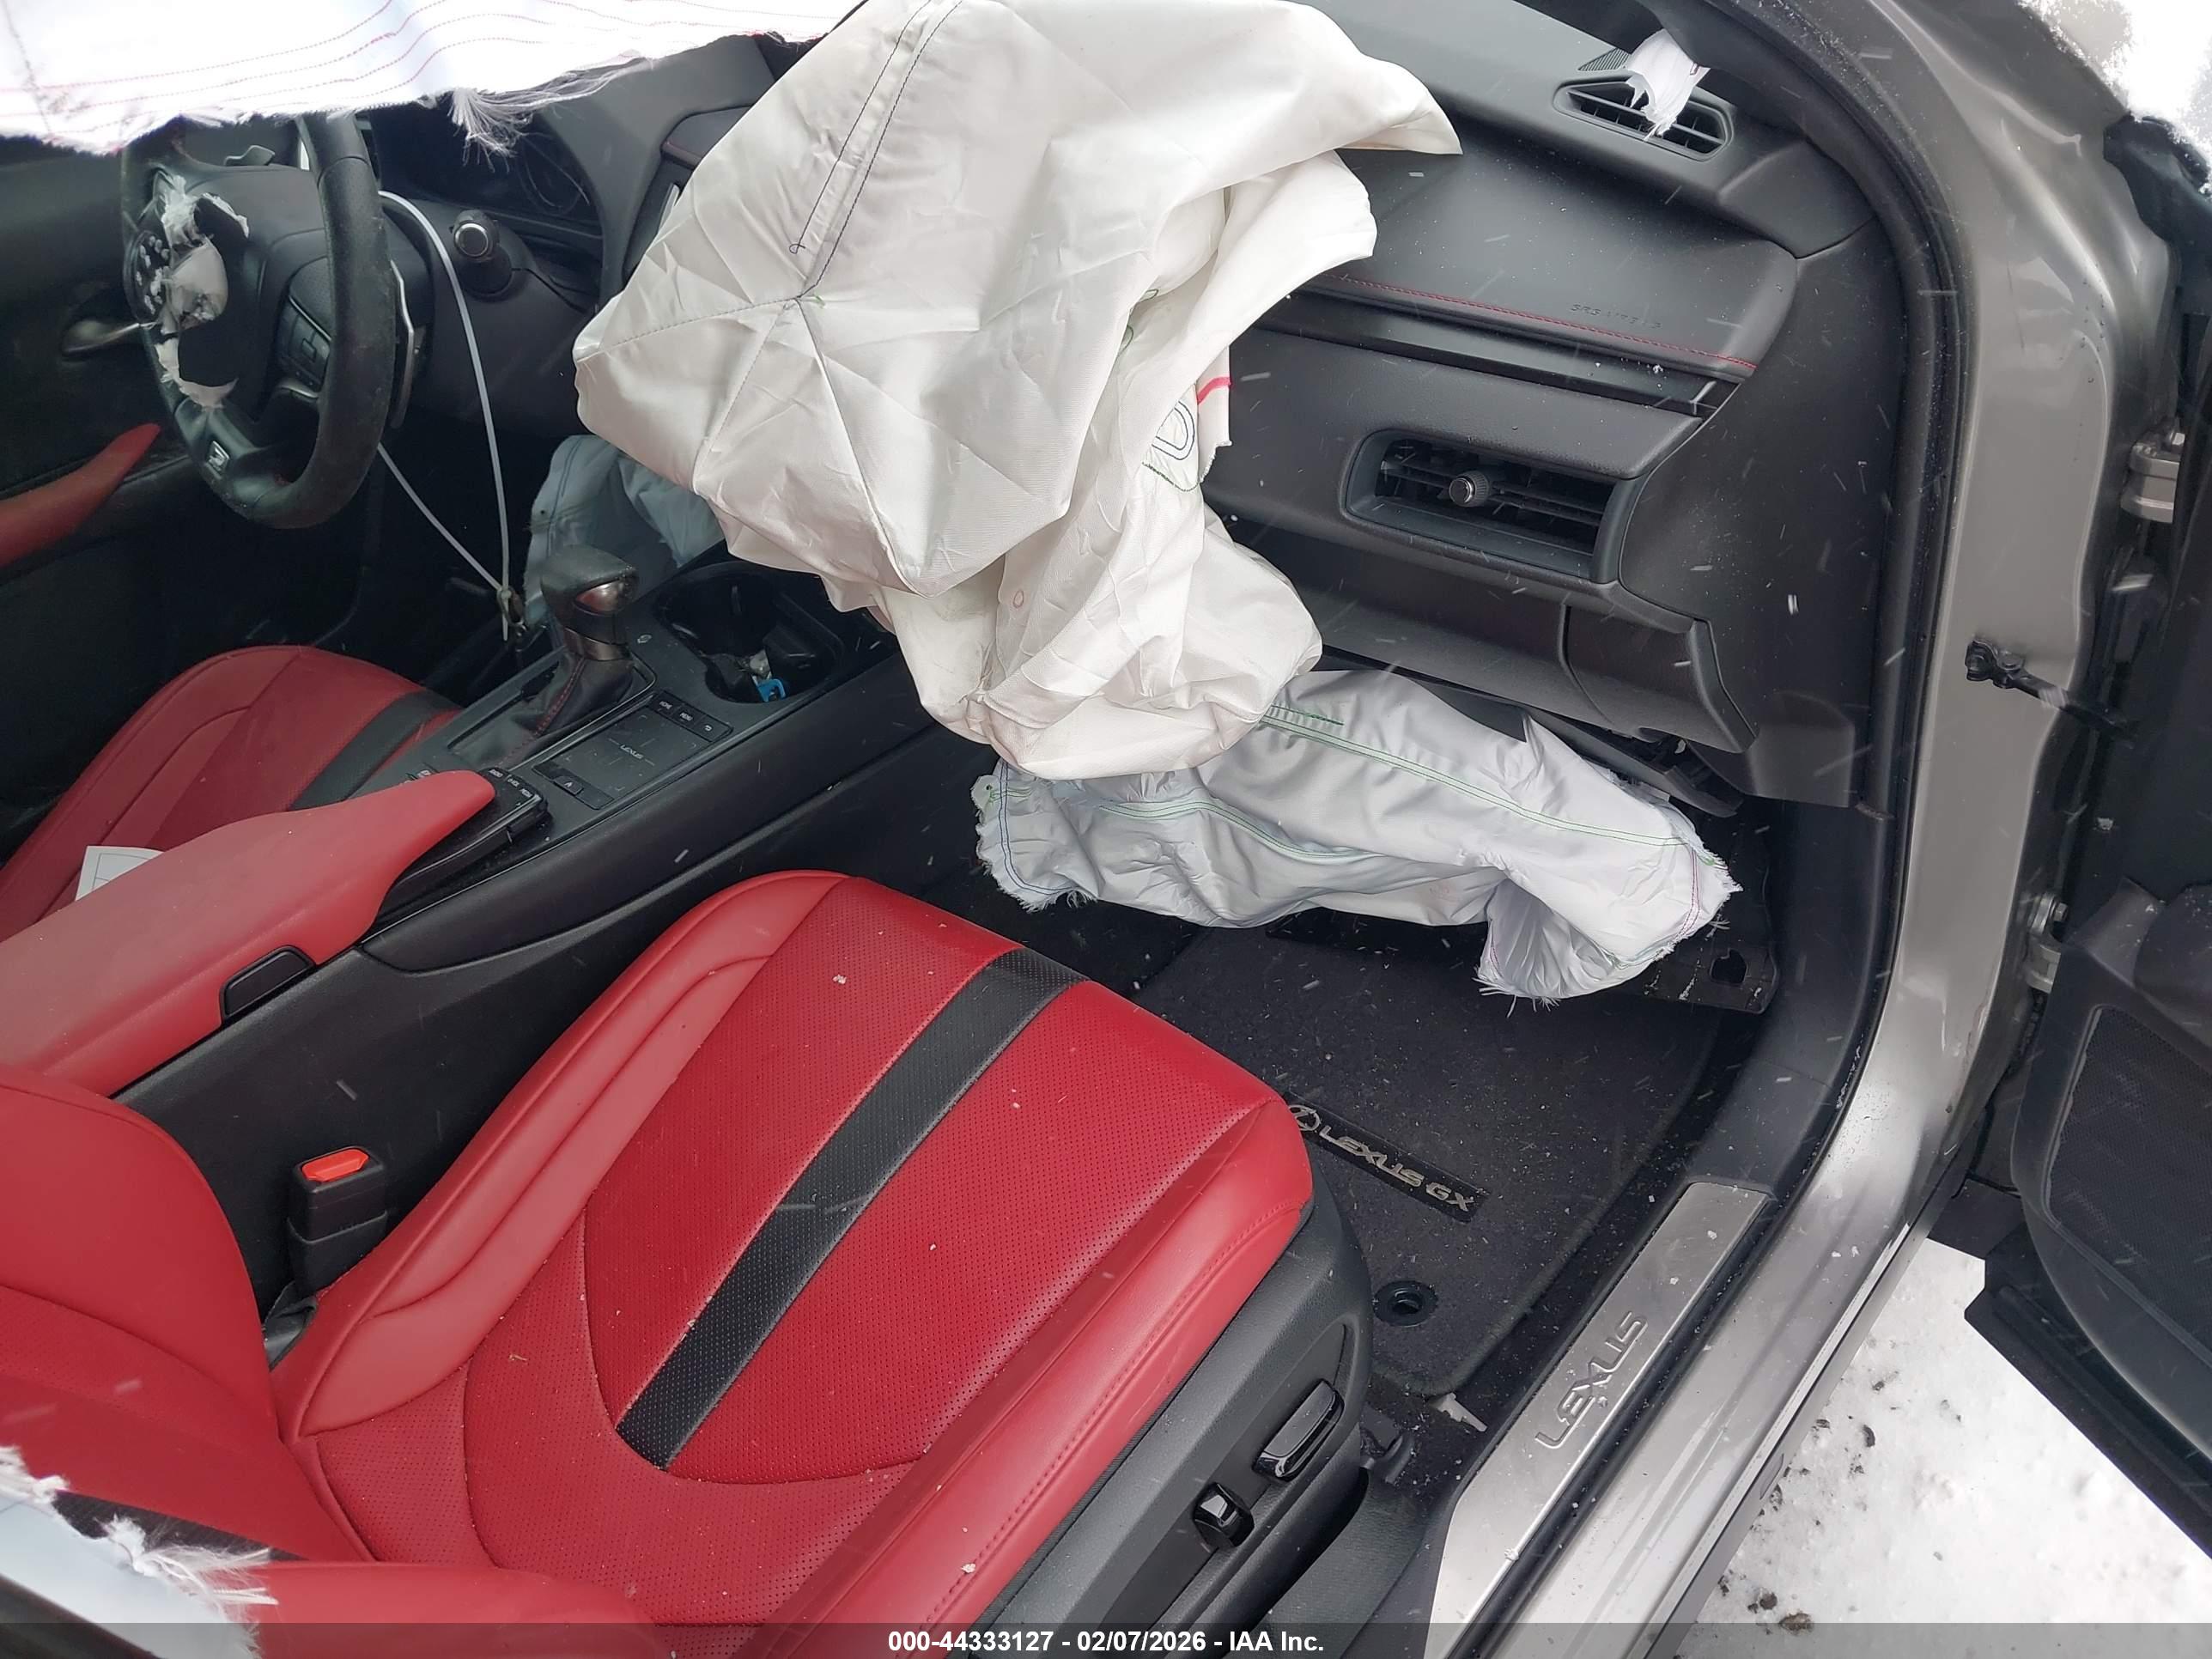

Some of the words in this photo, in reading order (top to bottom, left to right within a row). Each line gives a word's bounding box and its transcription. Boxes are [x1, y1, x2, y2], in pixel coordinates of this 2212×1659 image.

[620, 744, 644, 760] LEXUS
[1319, 1125, 1425, 1188] LEXUS
[1425, 1182, 1475, 1212] GX
[1534, 1311, 1649, 1449] LEXUS
